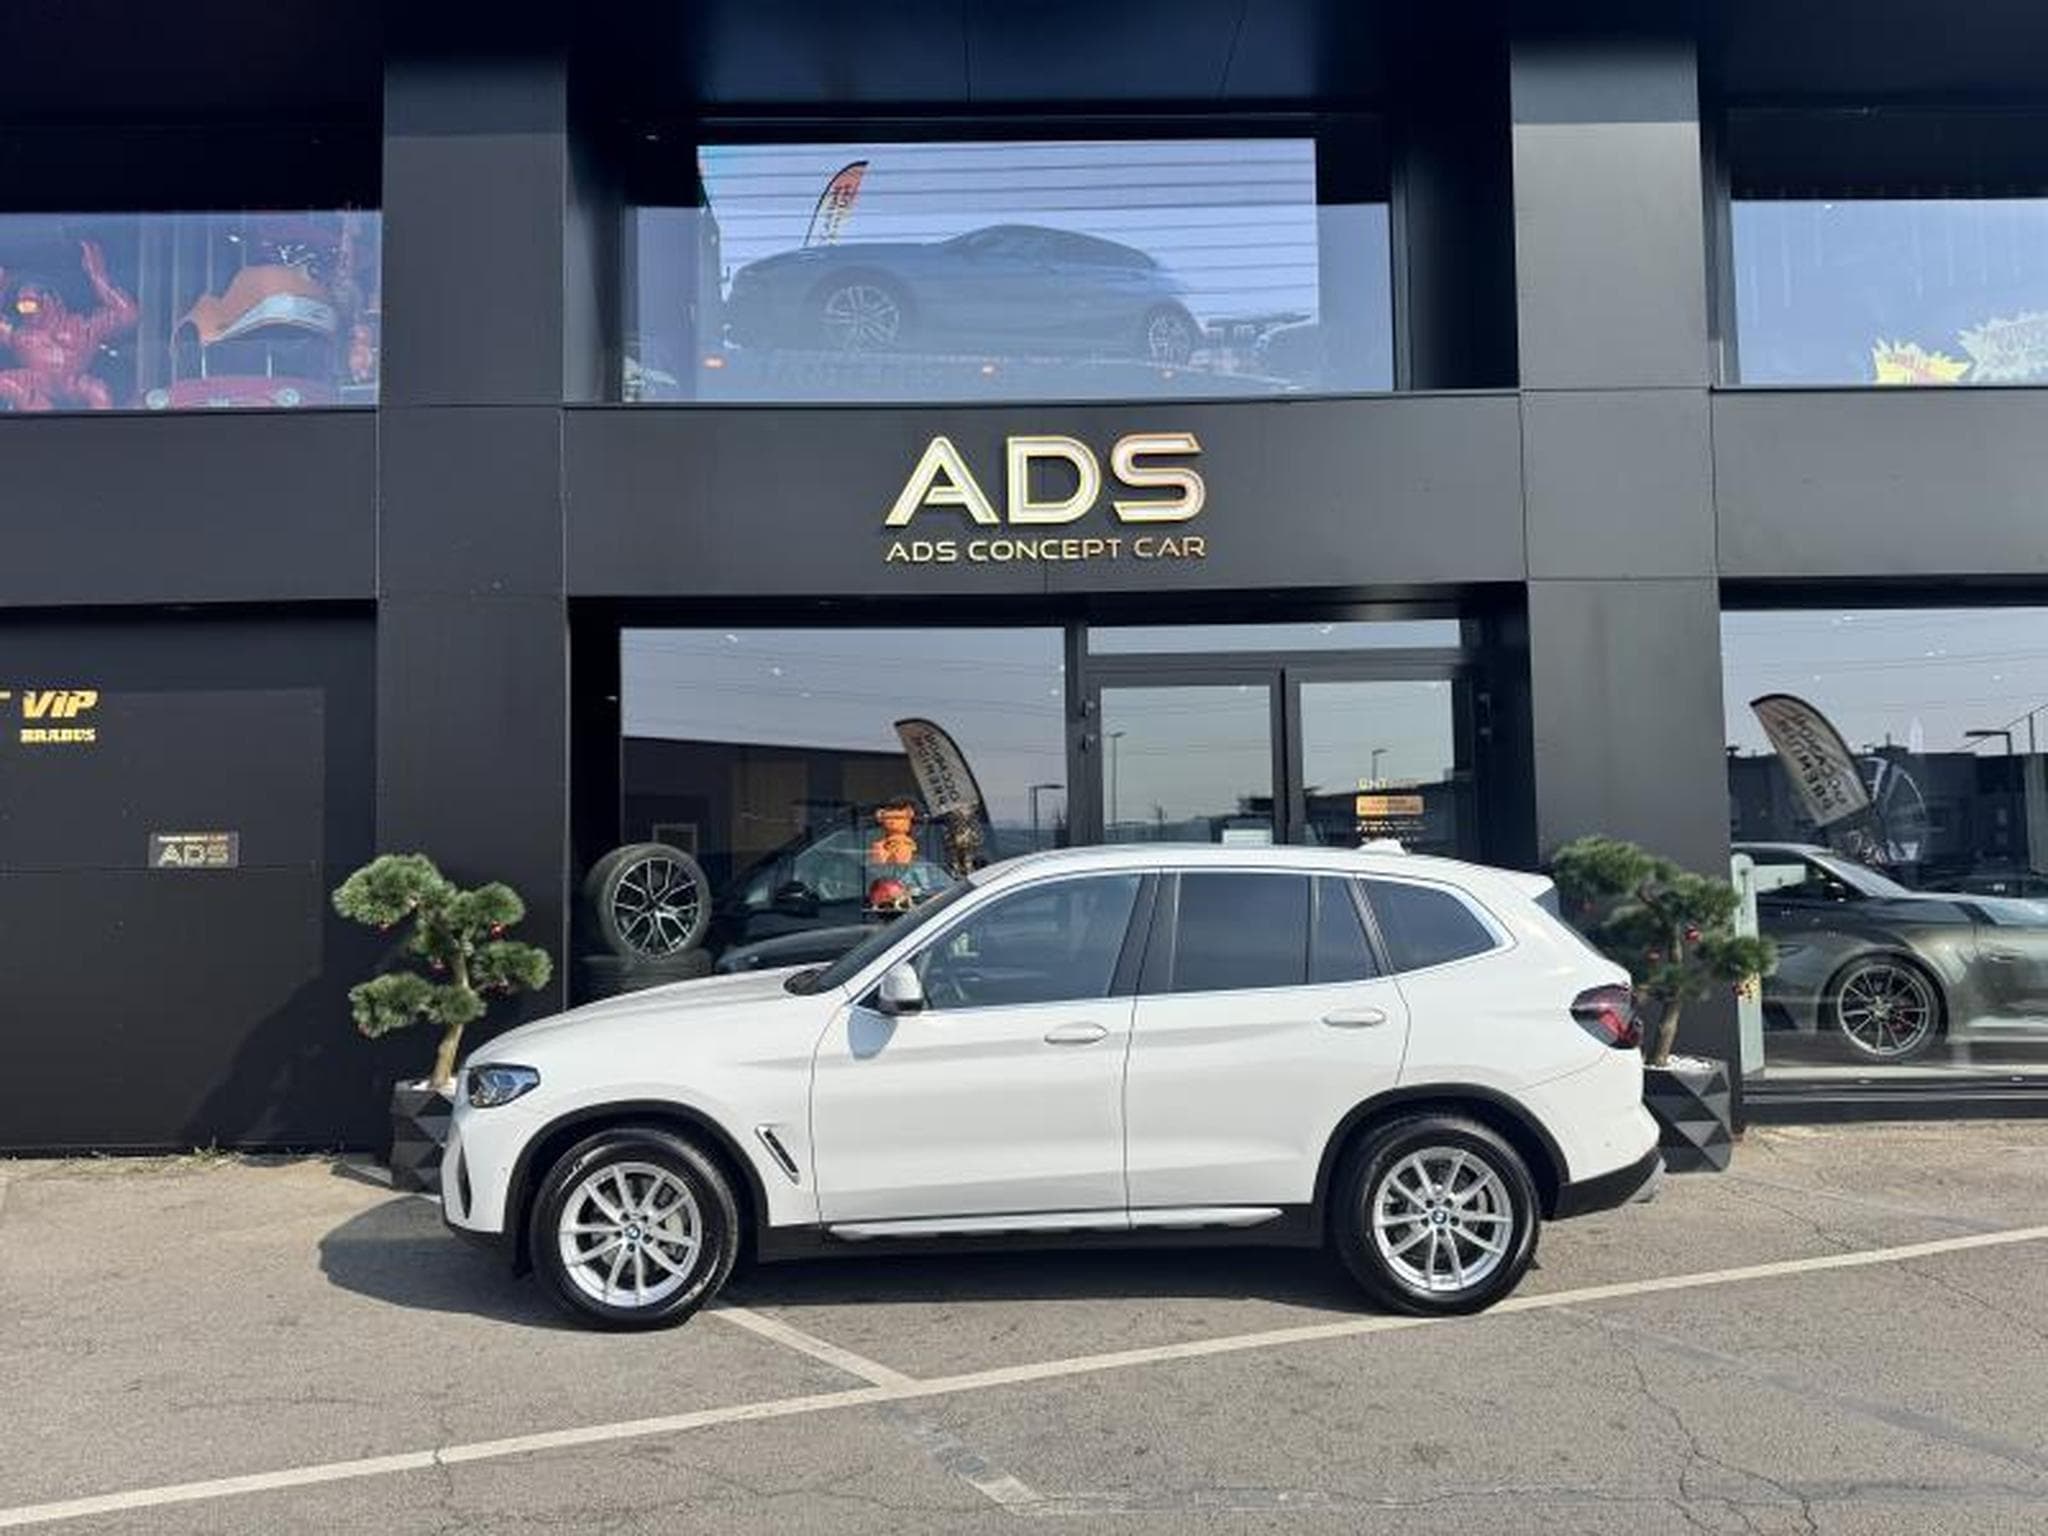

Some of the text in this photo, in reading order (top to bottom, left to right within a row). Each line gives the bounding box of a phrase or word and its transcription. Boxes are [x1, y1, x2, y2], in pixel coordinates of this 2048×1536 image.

[885, 432, 1206, 526] ADS
[885, 536, 1207, 563] ADS CONCEPT CAR
[158, 843, 229, 867] ADS
